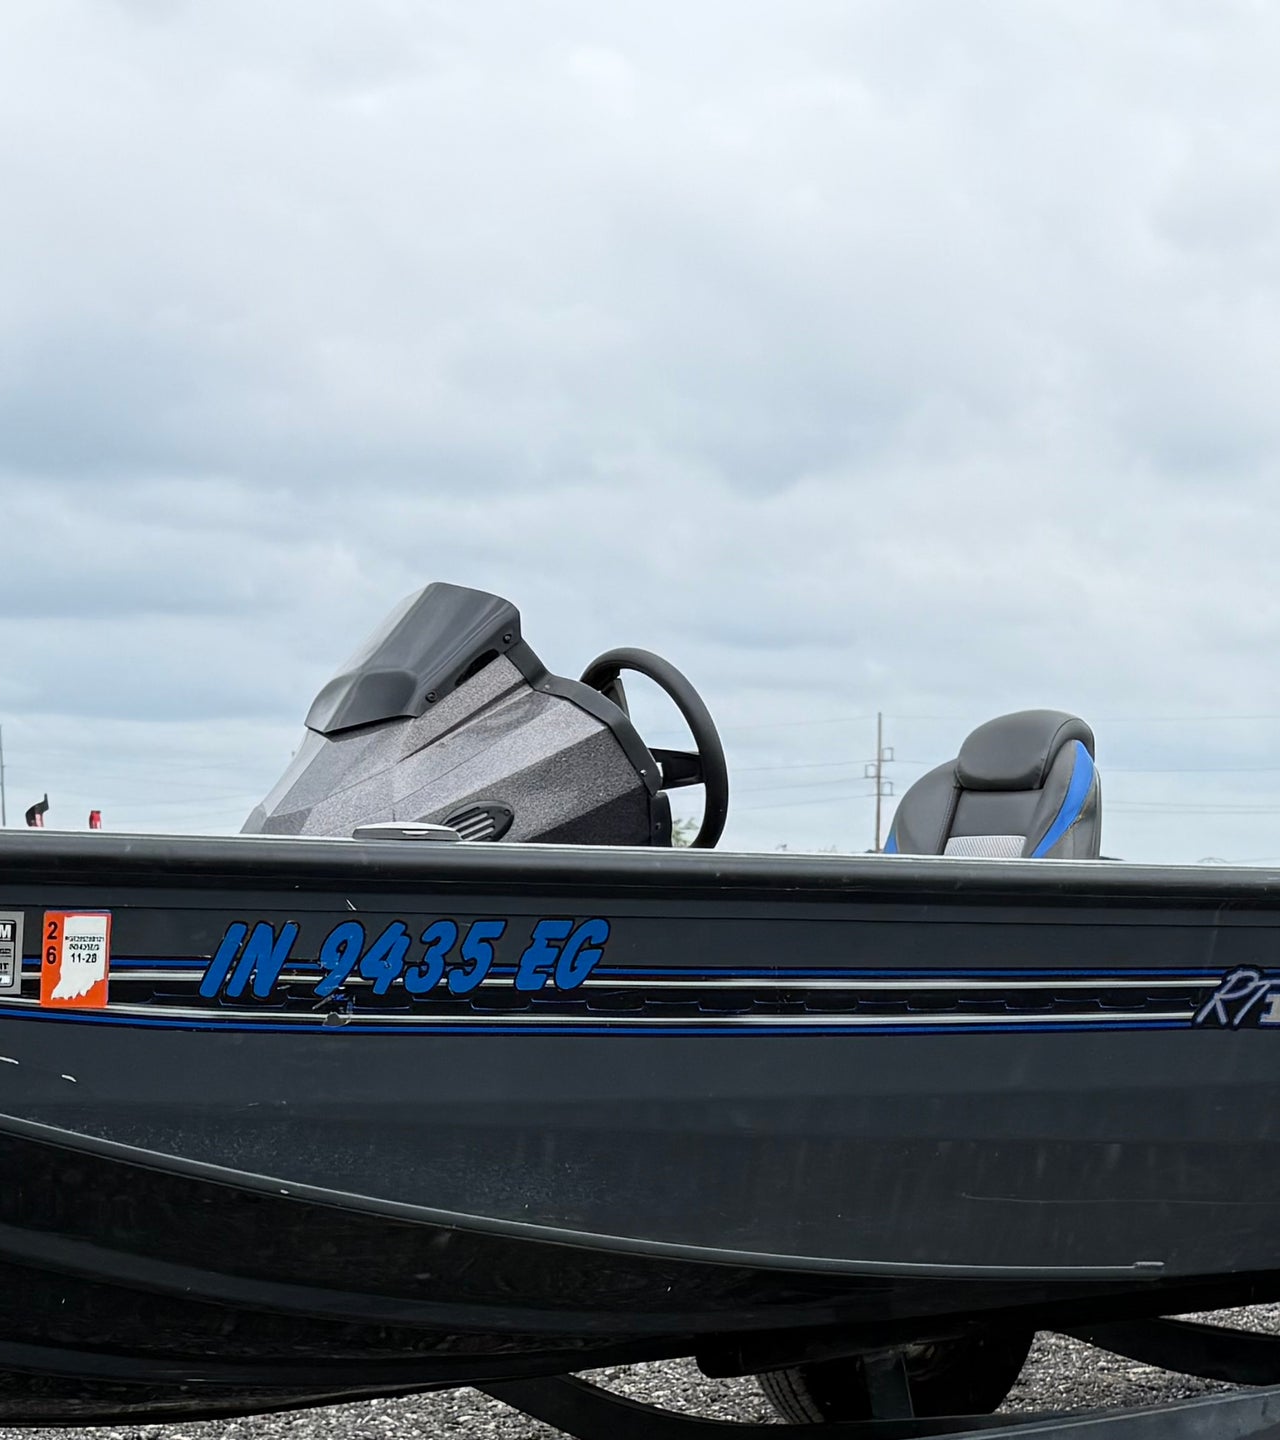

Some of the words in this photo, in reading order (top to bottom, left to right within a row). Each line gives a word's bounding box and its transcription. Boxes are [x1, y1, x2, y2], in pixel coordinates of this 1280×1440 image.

[198, 919, 300, 998] IN
[313, 918, 509, 997] 9435
[515, 917, 612, 992] EG
